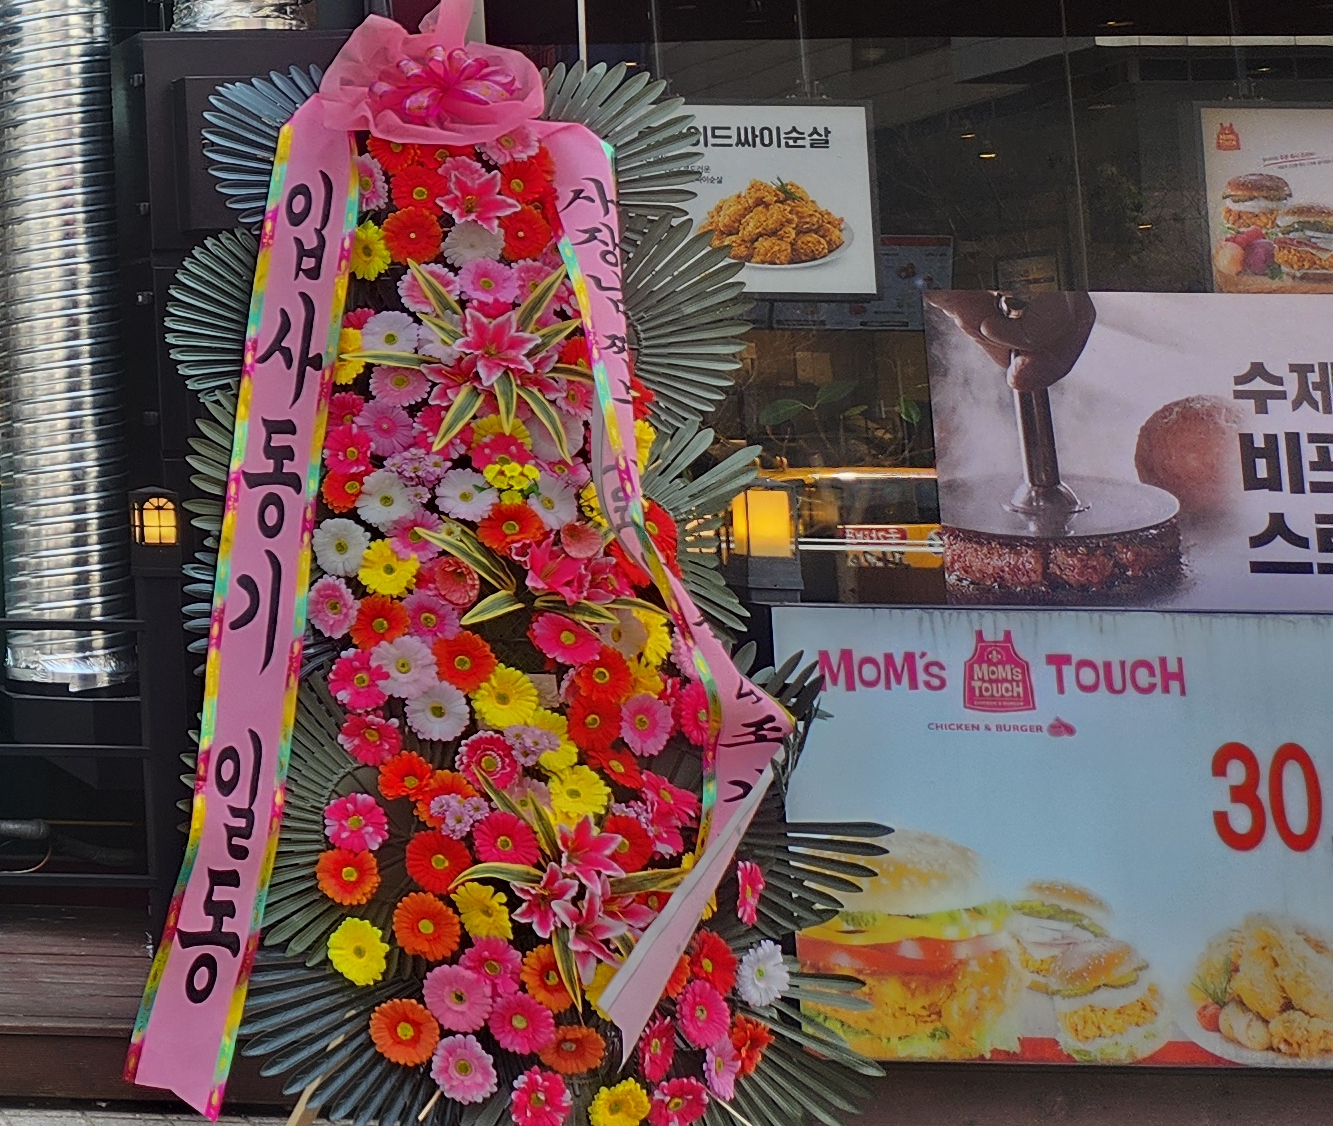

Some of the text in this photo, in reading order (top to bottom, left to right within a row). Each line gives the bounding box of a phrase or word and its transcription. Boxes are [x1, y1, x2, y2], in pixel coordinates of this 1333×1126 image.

[685, 125, 832, 149] 이드싸이순살
[175, 168, 334, 1005] 입사동기 일동
[927, 722, 981, 732] CHICKEN
[995, 723, 1044, 734] BURGER
[1211, 741, 1323, 853] 30
